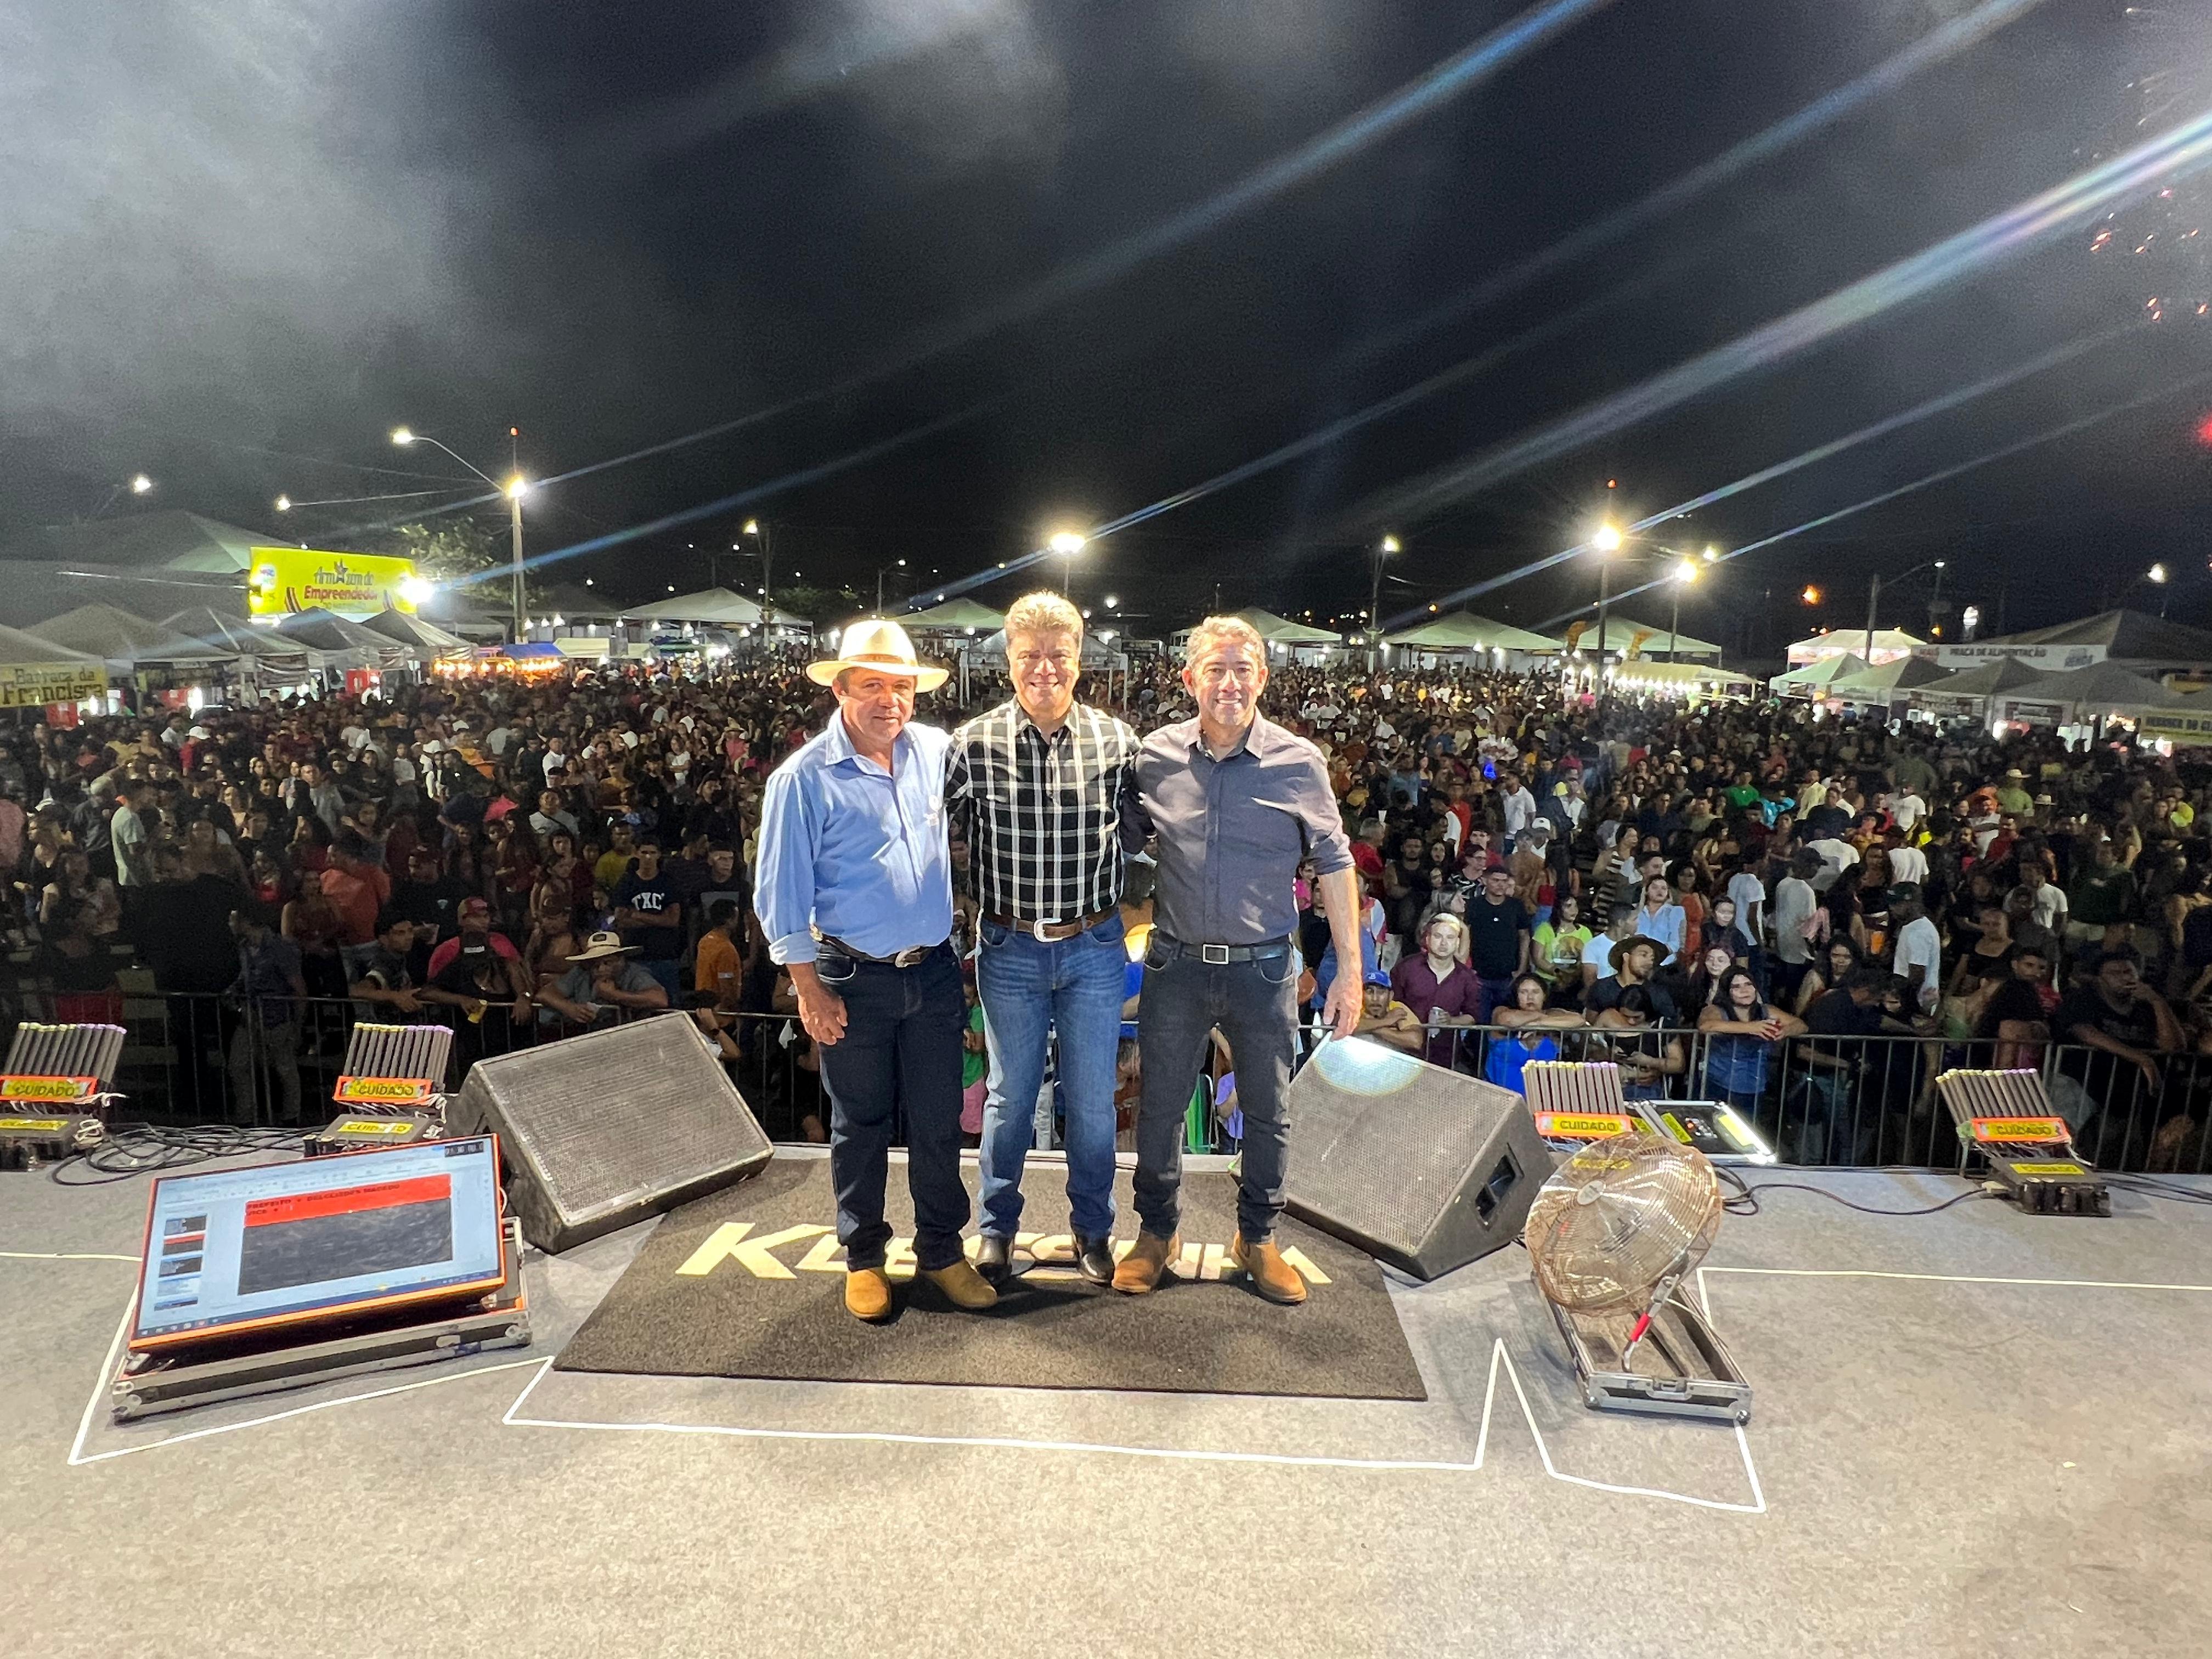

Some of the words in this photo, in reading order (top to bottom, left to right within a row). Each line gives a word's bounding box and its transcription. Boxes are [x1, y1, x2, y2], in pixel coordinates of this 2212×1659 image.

[79, 667, 94, 681] da
[14, 1084, 75, 1096] CUIDADO
[359, 1085, 414, 1096] CUIDADO
[347, 1124, 407, 1132] CUIDO
[1560, 1120, 1616, 1132] CUIDADO
[1997, 1126, 2052, 1135] CUIDADO
